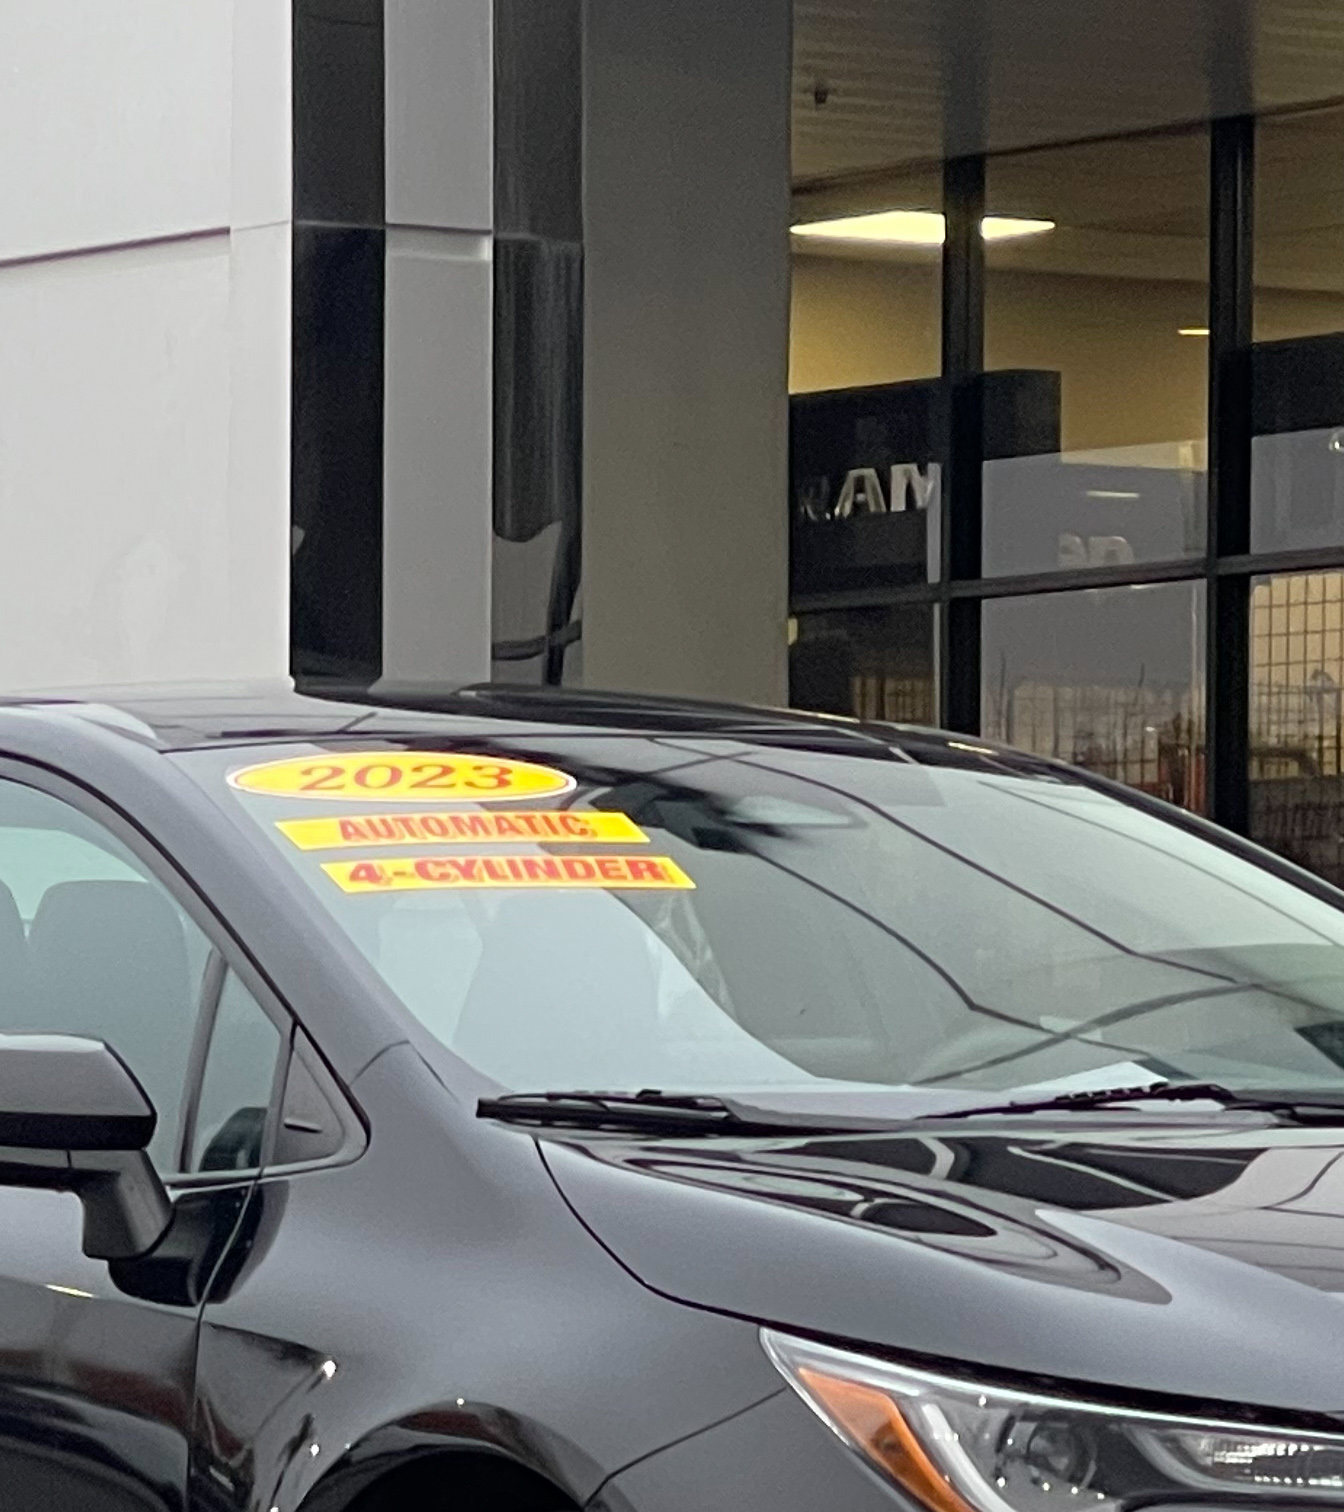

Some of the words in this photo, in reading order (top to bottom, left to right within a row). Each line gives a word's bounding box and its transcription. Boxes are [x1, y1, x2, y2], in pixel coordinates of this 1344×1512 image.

[299, 763, 515, 792] 2023
[338, 811, 594, 842] AUTOMATIC
[348, 856, 672, 885] 4-CYLINDER
